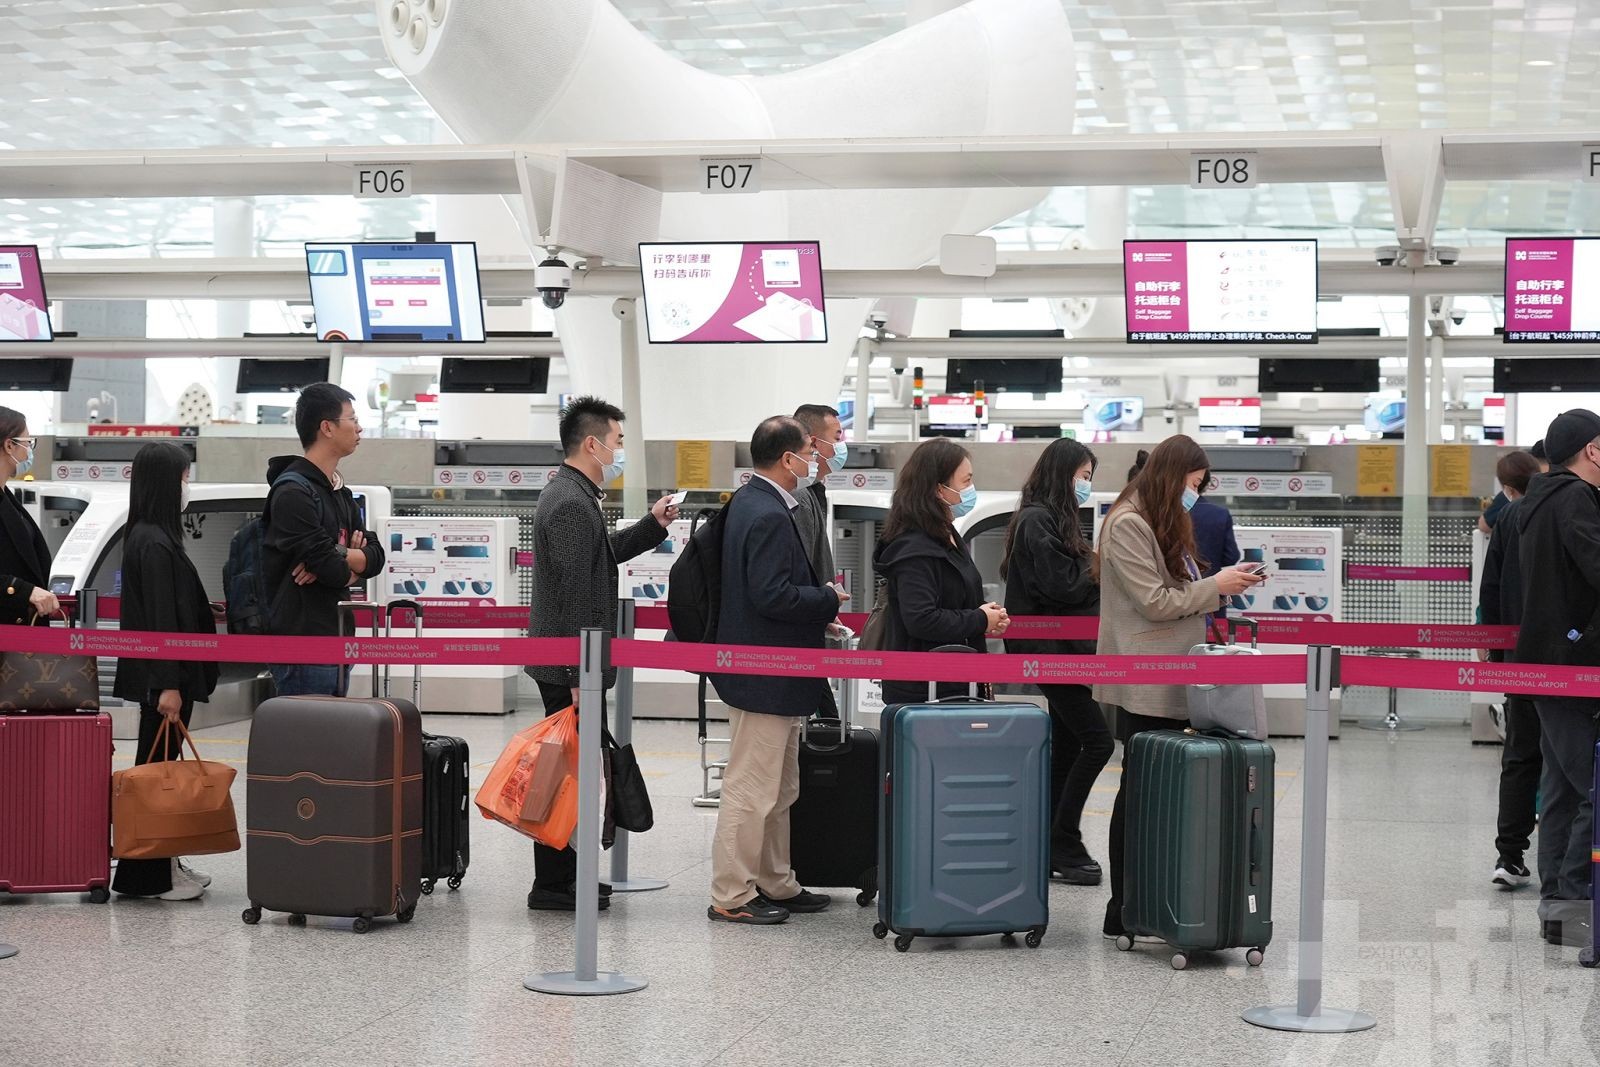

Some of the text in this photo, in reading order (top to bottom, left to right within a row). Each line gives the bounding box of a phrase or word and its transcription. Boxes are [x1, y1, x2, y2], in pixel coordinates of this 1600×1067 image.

[1198, 159, 1248, 183] F08
[360, 170, 404, 193] F06
[707, 165, 752, 188] F07
[653, 254, 711, 264] 行李到哪里
[654, 269, 711, 279] 扫码告诉你
[1135, 281, 1181, 292] 自助行李
[1516, 280, 1565, 290] 自助行李
[1134, 295, 1181, 306] 托运柜台
[1515, 294, 1564, 305] 托运柜台
[86, 635, 118, 643] SHENZHEN
[86, 643, 133, 651] INTERNATIONAL
[735, 652, 770, 660] SHENZHEN
[735, 661, 816, 671] INTERNATIONAL AIRPORT
[1042, 661, 1079, 669] SHENZHEN
[1478, 670, 1546, 679] SHENZHEN BAOAN
[1478, 679, 1536, 687] INTERNATIONAL
